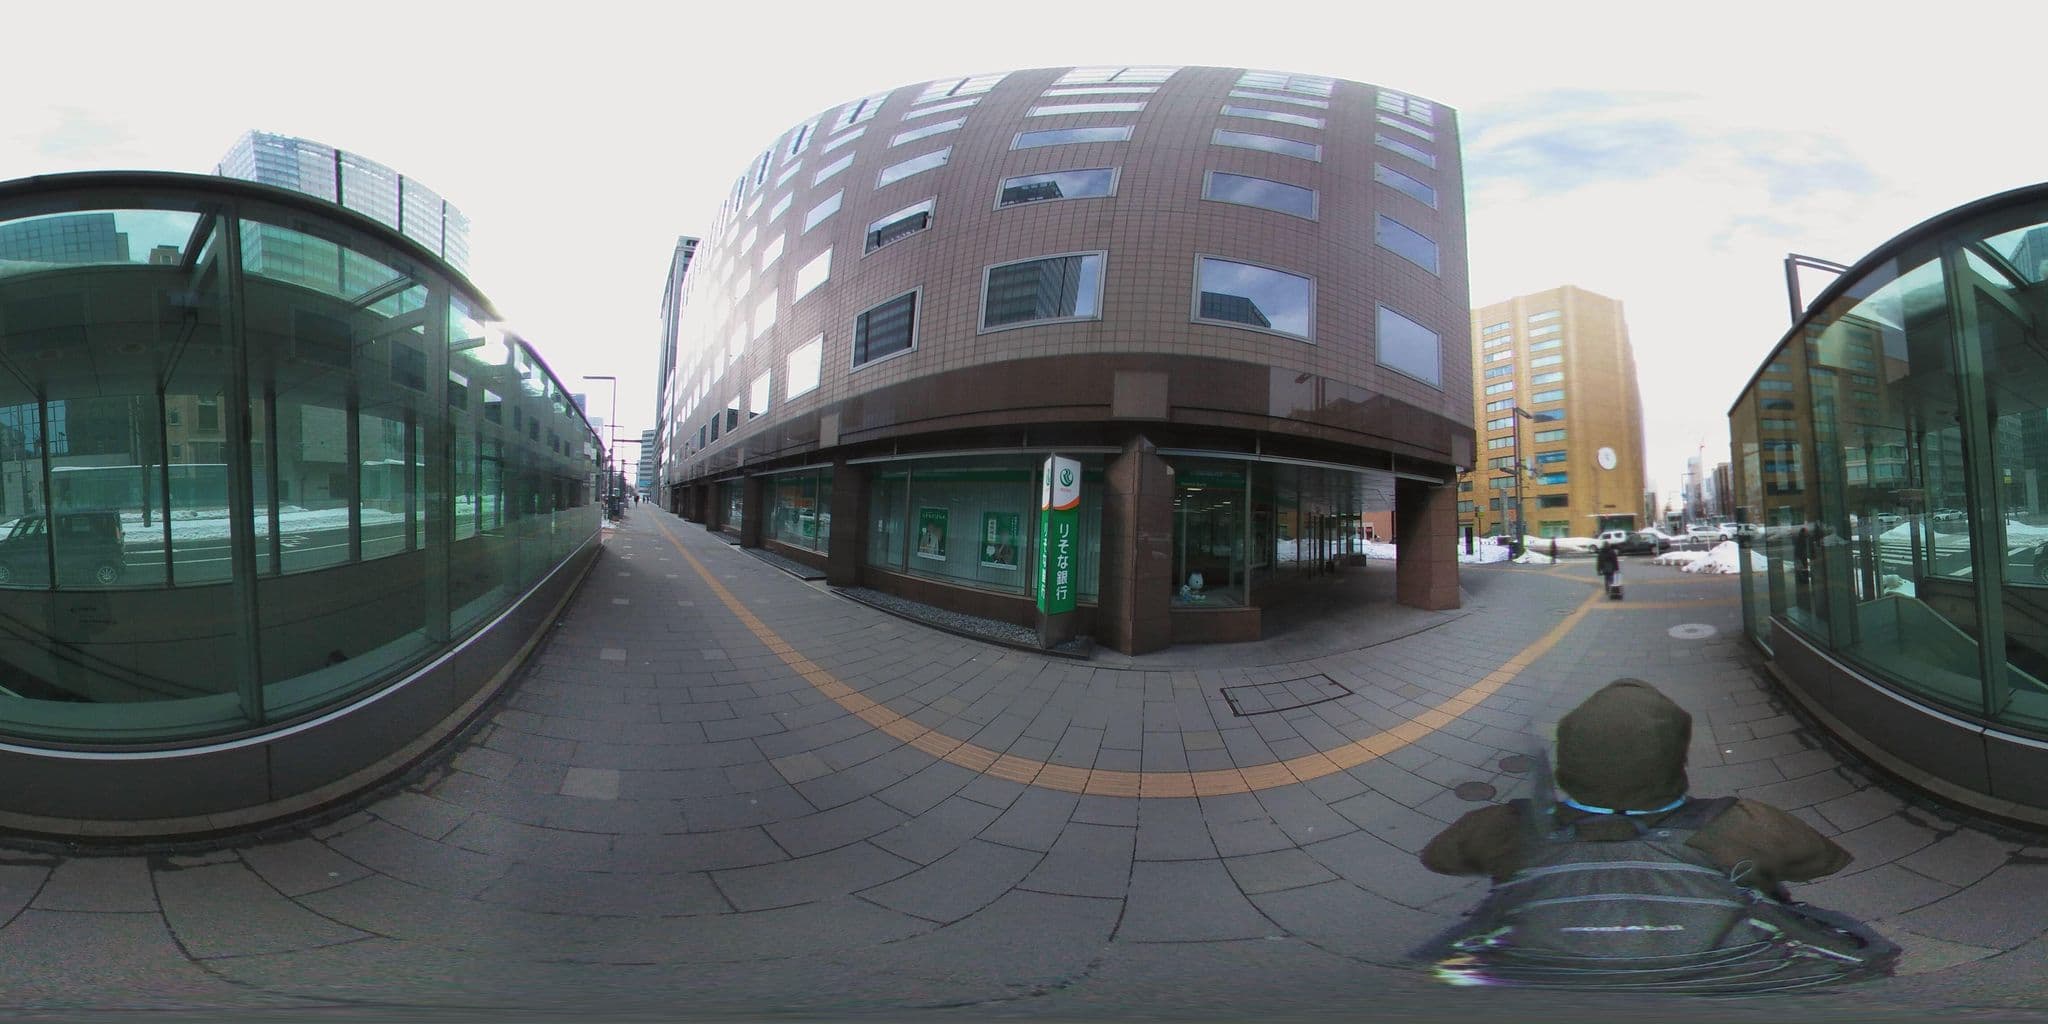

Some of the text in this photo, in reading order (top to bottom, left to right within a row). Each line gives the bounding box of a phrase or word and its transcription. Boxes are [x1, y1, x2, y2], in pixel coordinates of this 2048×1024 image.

[1056, 523, 1070, 601] りそな銀行
